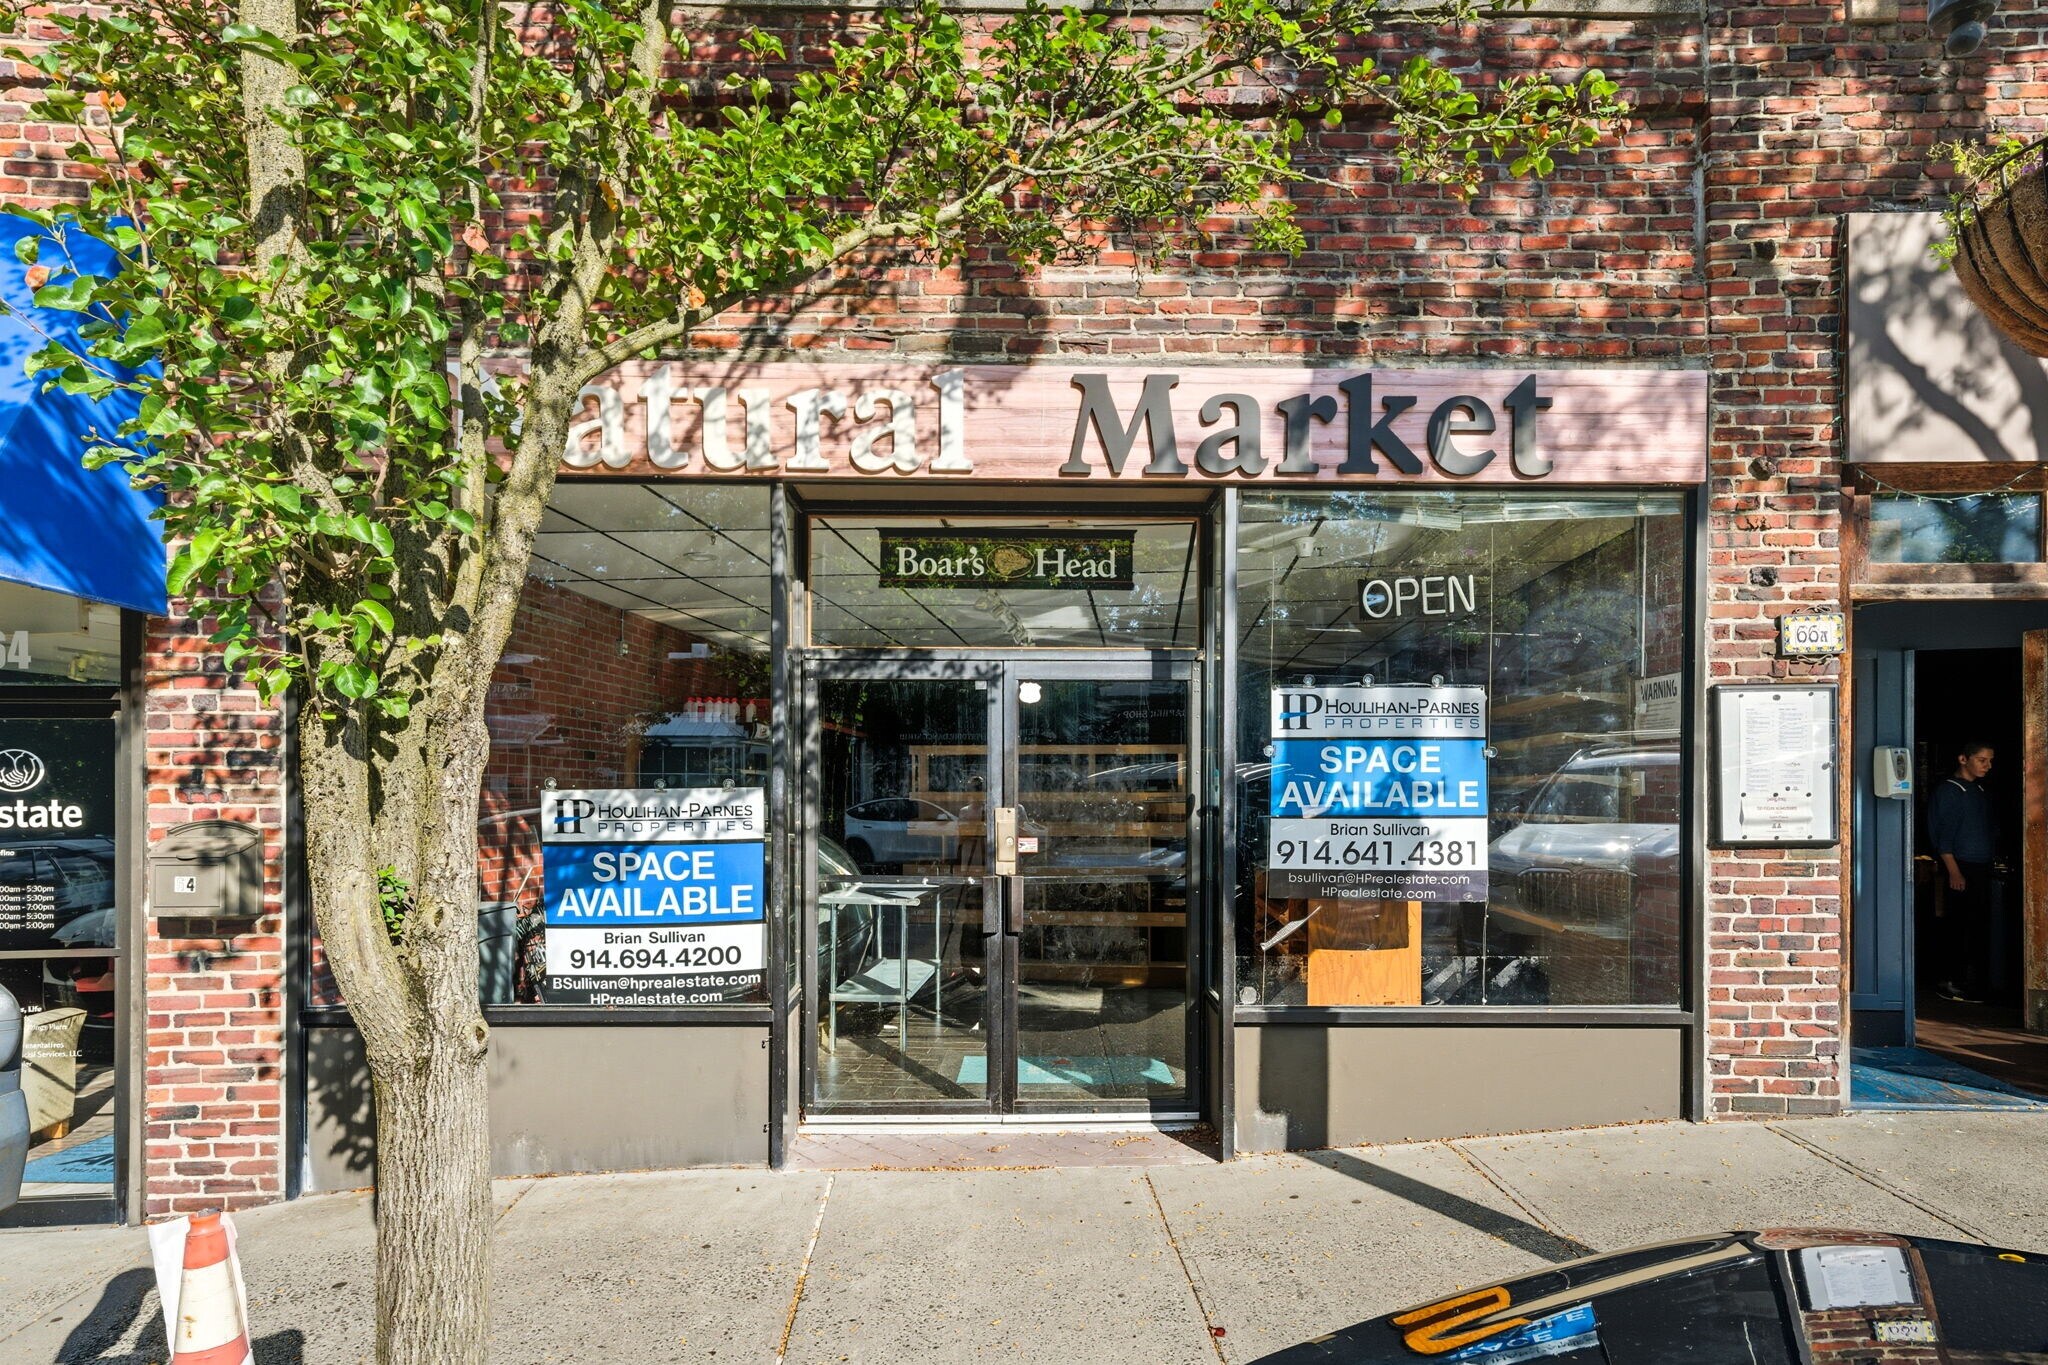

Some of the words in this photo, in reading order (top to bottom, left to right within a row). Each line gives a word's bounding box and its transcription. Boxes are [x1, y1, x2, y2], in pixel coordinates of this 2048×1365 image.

[1059, 371, 1555, 479] Market
[896, 546, 985, 577] Boar's
[1035, 548, 1117, 579] Head
[1362, 574, 1475, 618] OPEN
[1641, 680, 1678, 701] WARNING
[1324, 717, 1480, 729] PROPERTIES
[1319, 745, 1442, 774] SPACE
[1278, 780, 1480, 809] AVAILABLE
[0, 799, 83, 828] state
[597, 819, 754, 833] PROPERTIES
[1330, 823, 1369, 837] Brian
[1372, 823, 1431, 837] Sullivan
[1276, 839, 1477, 867] 914.641.4381
[592, 850, 716, 883] SPACE
[1287, 871, 1471, 886] bsullivan@HPrealestate.com
[556, 884, 755, 918] AVAILABLE
[1320, 886, 1437, 900] HPrealestate.com
[604, 932, 642, 945] Brian
[648, 930, 706, 945] Sullivan
[570, 945, 742, 969] 914.694.4200
[552, 973, 761, 992] BSullivan@hprealestate.com
[590, 991, 723, 1006] HPrealestate.com
